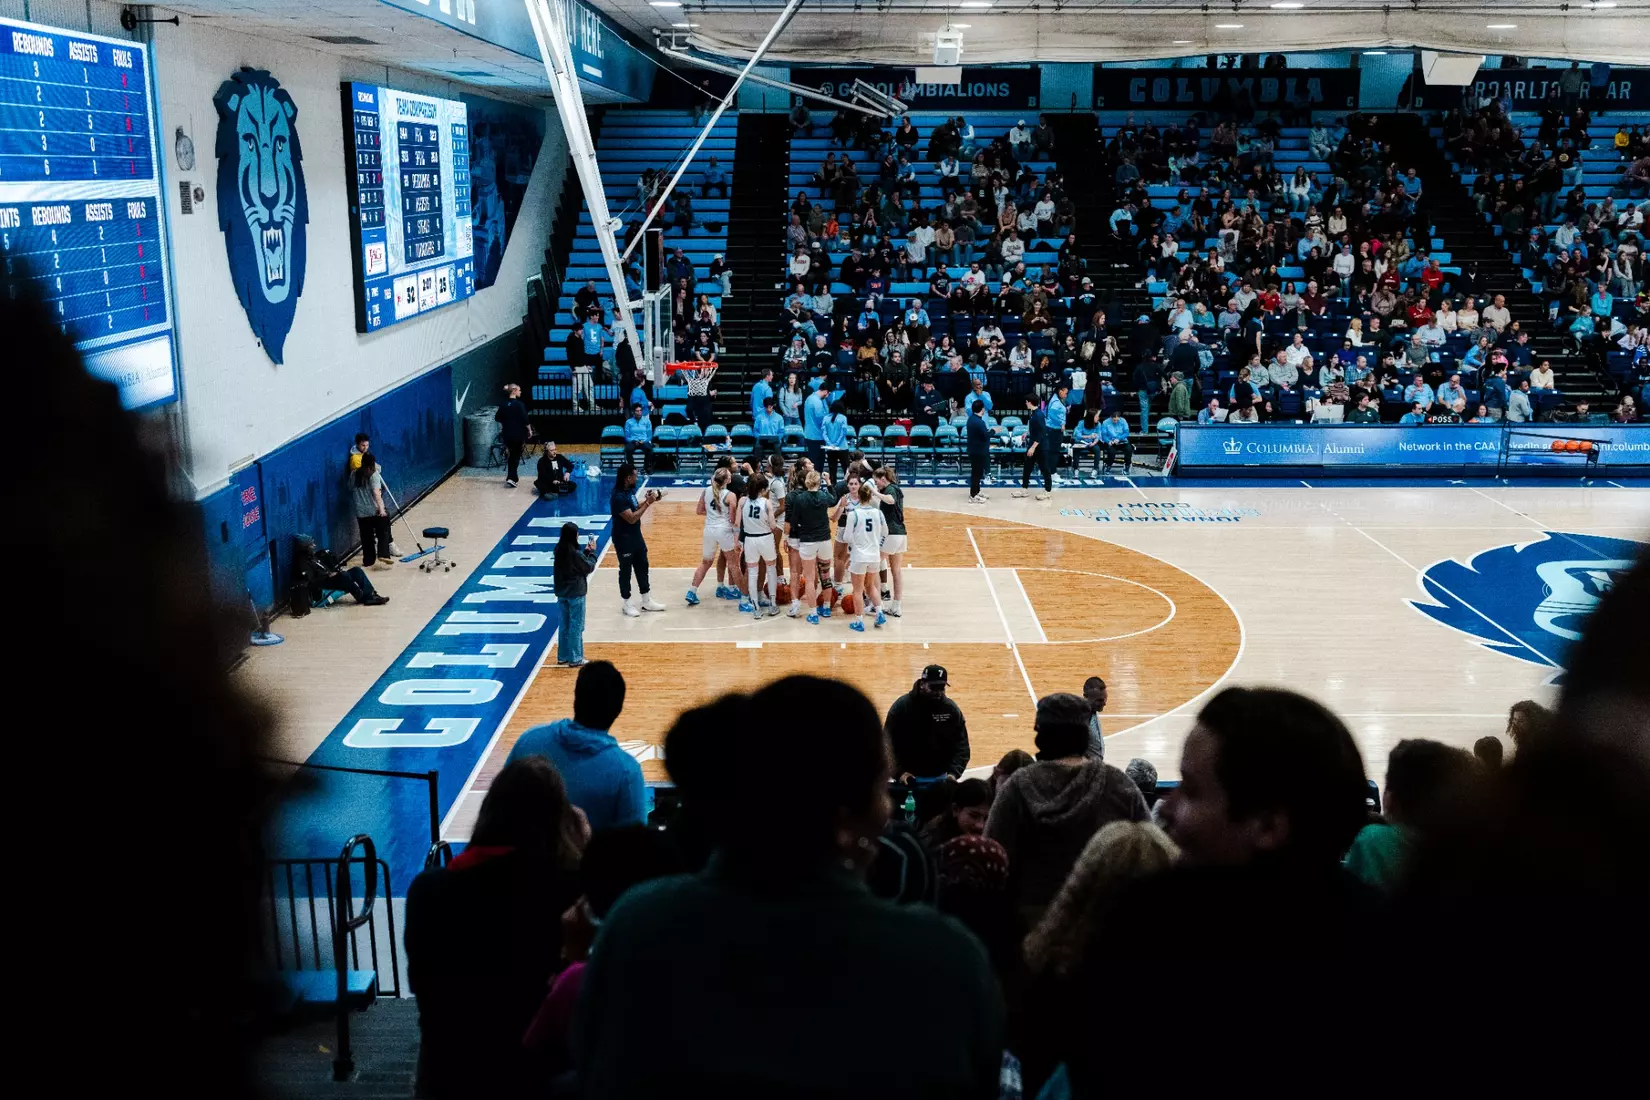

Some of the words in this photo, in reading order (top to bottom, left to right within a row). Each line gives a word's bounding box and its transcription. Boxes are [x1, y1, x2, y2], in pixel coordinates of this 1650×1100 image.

[12, 31, 54, 57] REBOUNDS
[68, 41, 98, 63] ASSISTS
[112, 49, 132, 68] FOULS
[33, 61, 39, 78] 3
[83, 67, 88, 83] 1
[36, 86, 41, 102] 2
[86, 90, 90, 106] 1
[39, 111, 45, 127] 2
[87, 114, 93, 130] 5
[41, 135, 47, 151] 3
[90, 137, 95, 152] 0
[44, 159, 50, 175] 6
[92, 159, 97, 175] 1
[0, 208, 20, 229] INTS
[32, 205, 71, 226] REBOUNDS
[85, 203, 113, 222] ASSISTS
[127, 202, 146, 219] FOULS
[3, 233, 10, 250] 5
[51, 229, 57, 245] 4
[99, 225, 104, 240] 2
[54, 253, 59, 268] 2
[101, 248, 106, 263] 1
[56, 277, 62, 292] 4
[103, 270, 109, 285] 0
[58, 301, 65, 316] 4
[106, 292, 111, 307] 1
[108, 314, 113, 329] 2
[1246, 442, 1314, 454] COLUMBIA
[1323, 442, 1365, 454] Alumni
[1399, 442, 1441, 451] Network
[1443, 442, 1453, 451] in
[1454, 442, 1472, 451] the
[1474, 442, 1496, 451] CAA
[748, 504, 761, 519] 12
[865, 518, 873, 532] 5
[342, 514, 612, 748] COLUMBIA
[938, 669, 944, 678] 7
